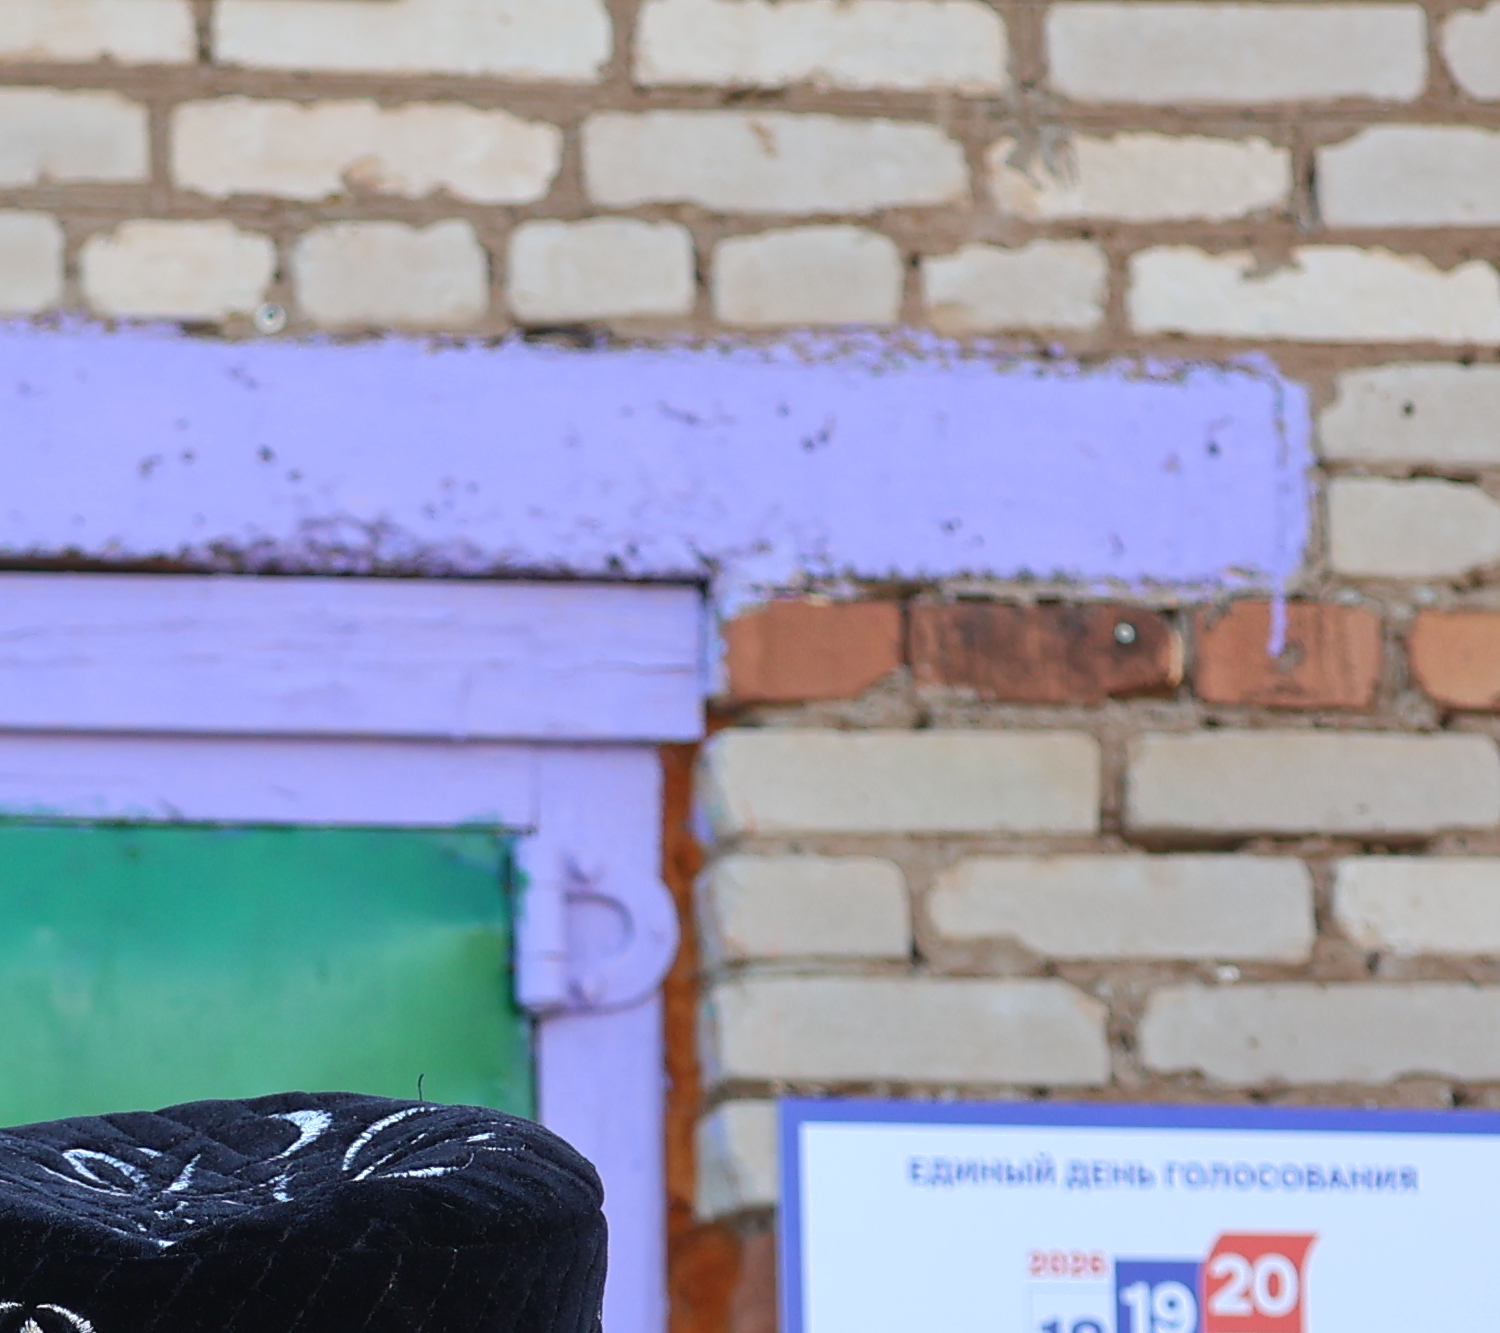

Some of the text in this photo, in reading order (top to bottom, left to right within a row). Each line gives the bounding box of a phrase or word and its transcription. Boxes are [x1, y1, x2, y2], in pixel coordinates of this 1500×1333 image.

[909, 1154, 1418, 1191] ЕДИНЫЙ ДЕНЬ ГОЛОСОВАНИЯ
[1029, 1251, 1106, 1277] 2026
[1207, 1252, 1300, 1317] 20
